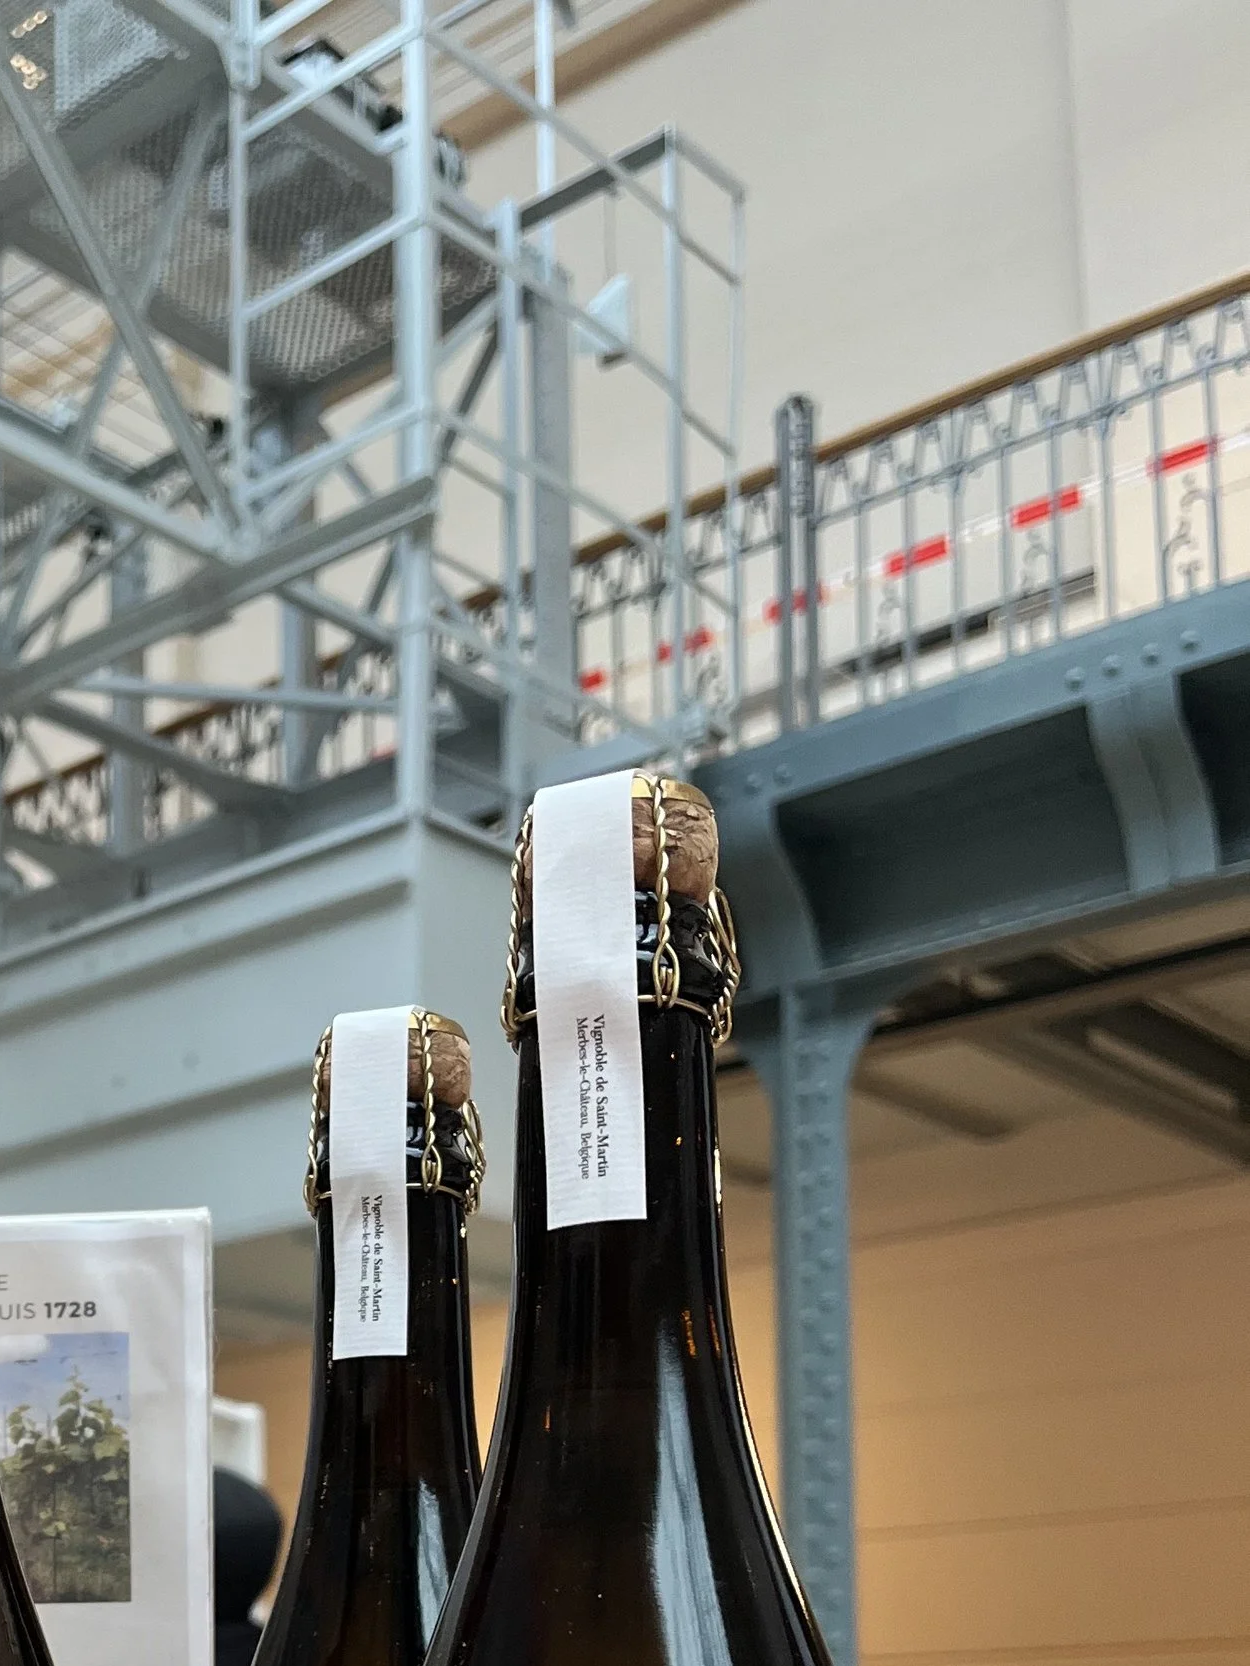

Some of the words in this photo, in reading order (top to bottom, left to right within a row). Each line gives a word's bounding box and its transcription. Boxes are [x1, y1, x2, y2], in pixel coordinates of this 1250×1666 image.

[590, 1013, 608, 1072] Vignoble
[596, 1076, 608, 1092] de
[578, 1132, 592, 1179] Belgique
[596, 1096, 608, 1177] Saint-Martin
[371, 1195, 384, 1240] Vignoble
[374, 1243, 384, 1255] de
[44, 1301, 97, 1319] 1728
[372, 1259, 383, 1321] Saint-Martin
